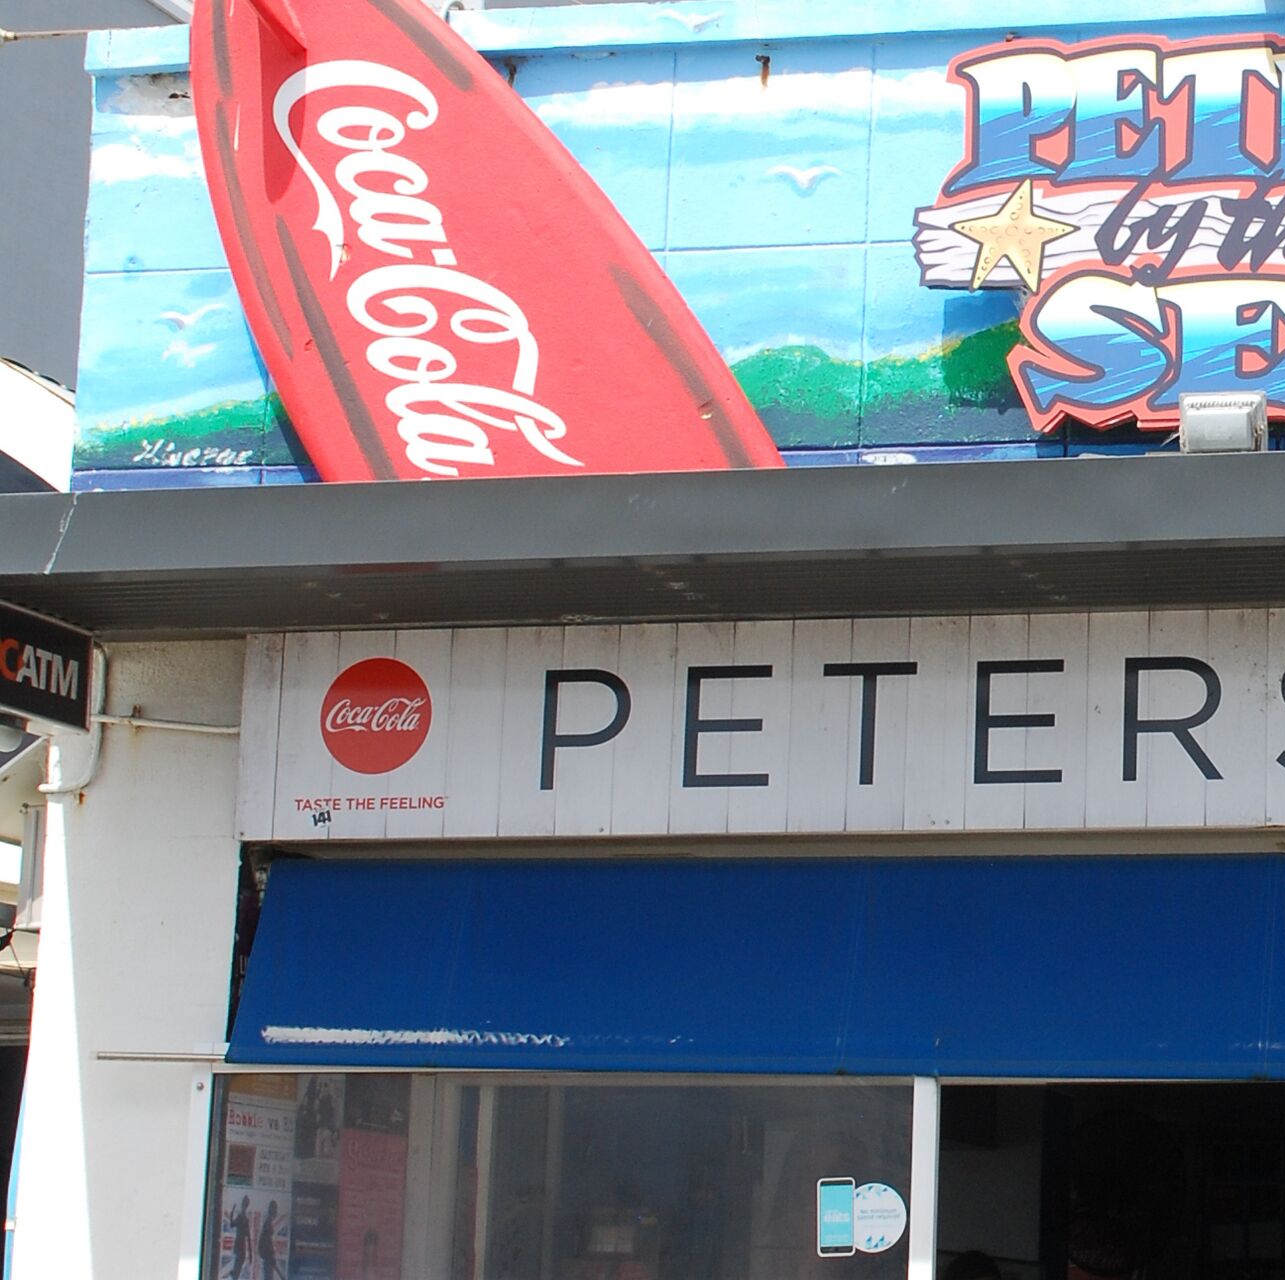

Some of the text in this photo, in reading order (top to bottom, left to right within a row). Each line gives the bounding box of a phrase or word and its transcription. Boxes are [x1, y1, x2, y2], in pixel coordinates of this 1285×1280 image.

[1096, 177, 1208, 283] by
[273, 60, 585, 478] Coca-Cola
[325, 697, 427, 733] Coca-Cola
[294, 796, 446, 812] TASTE THE FEELING
